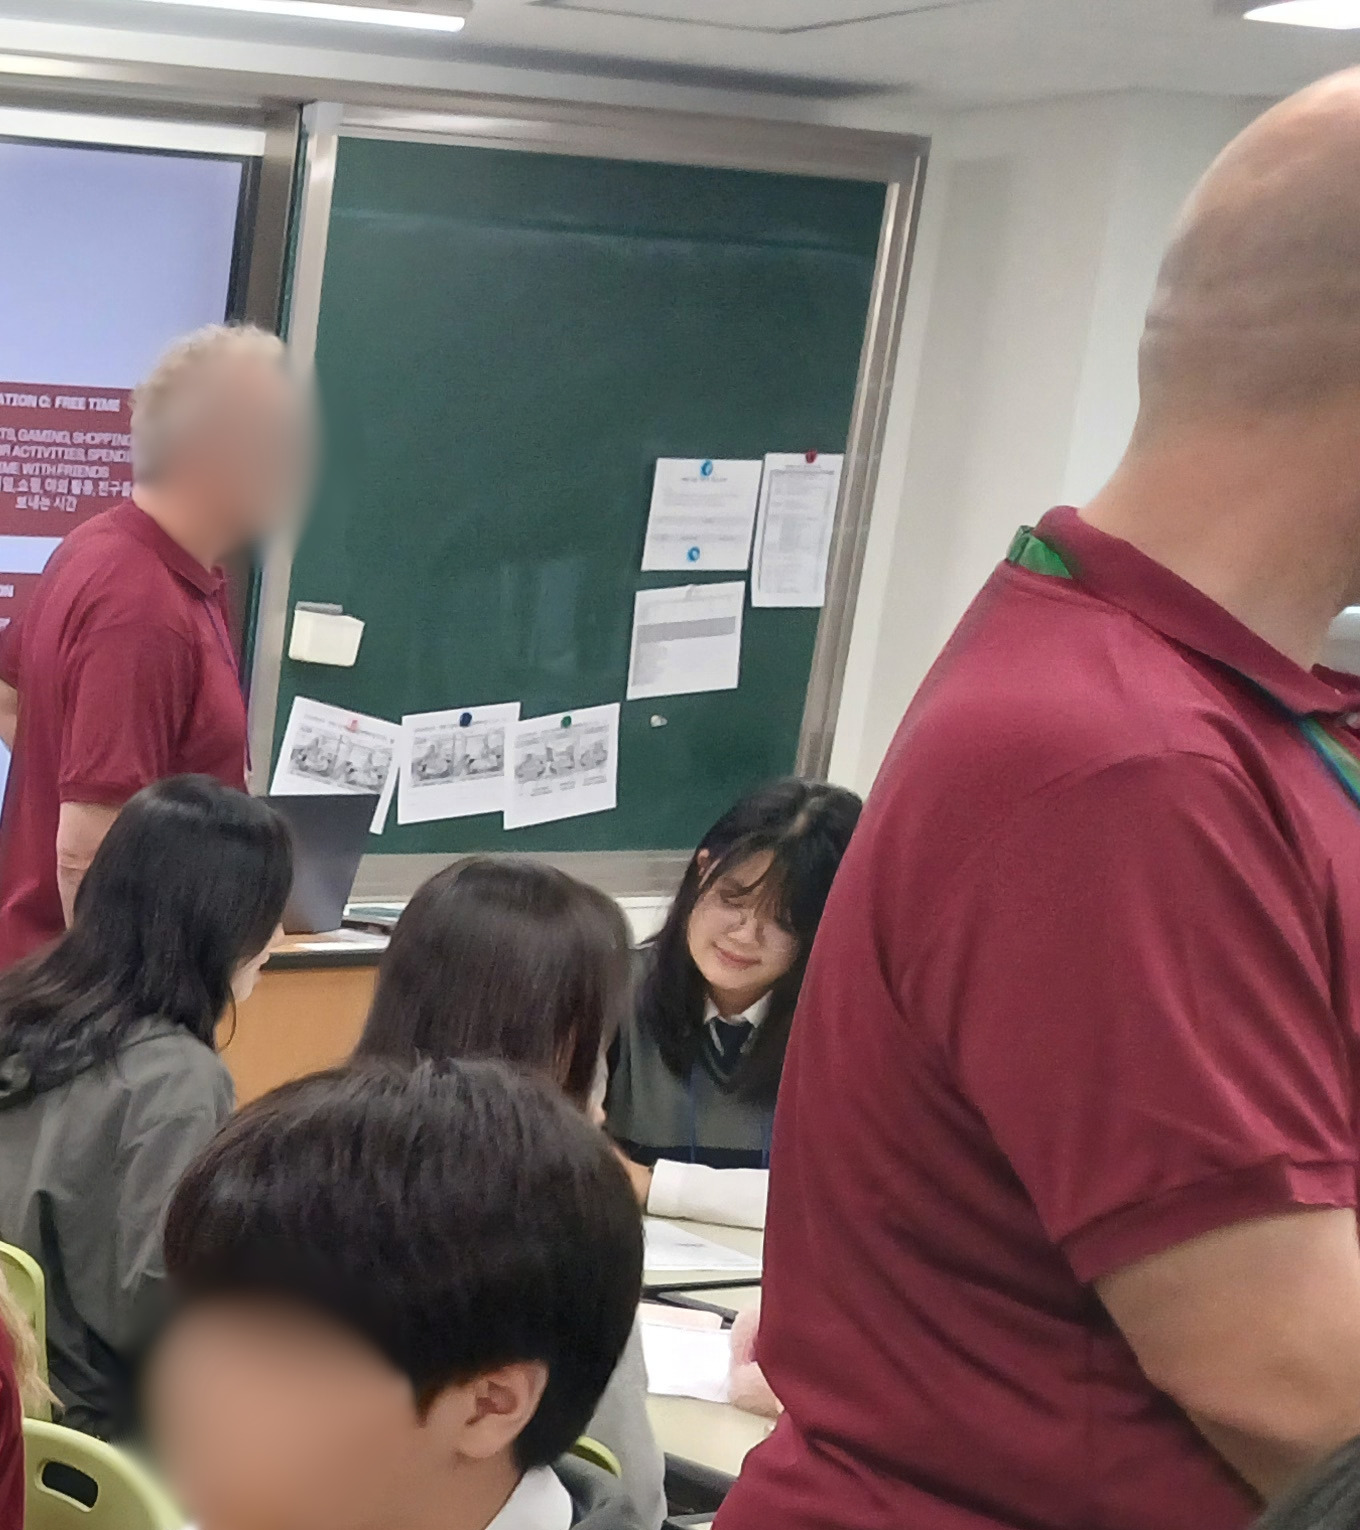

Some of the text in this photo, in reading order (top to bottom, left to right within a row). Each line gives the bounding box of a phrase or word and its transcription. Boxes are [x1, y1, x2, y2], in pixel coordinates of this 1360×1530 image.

[54, 395, 86, 410] FREE
[88, 397, 121, 412] TIME
[22, 462, 57, 476] WITH
[57, 464, 110, 478] FRIENDS
[53, 495, 77, 512] 시간
